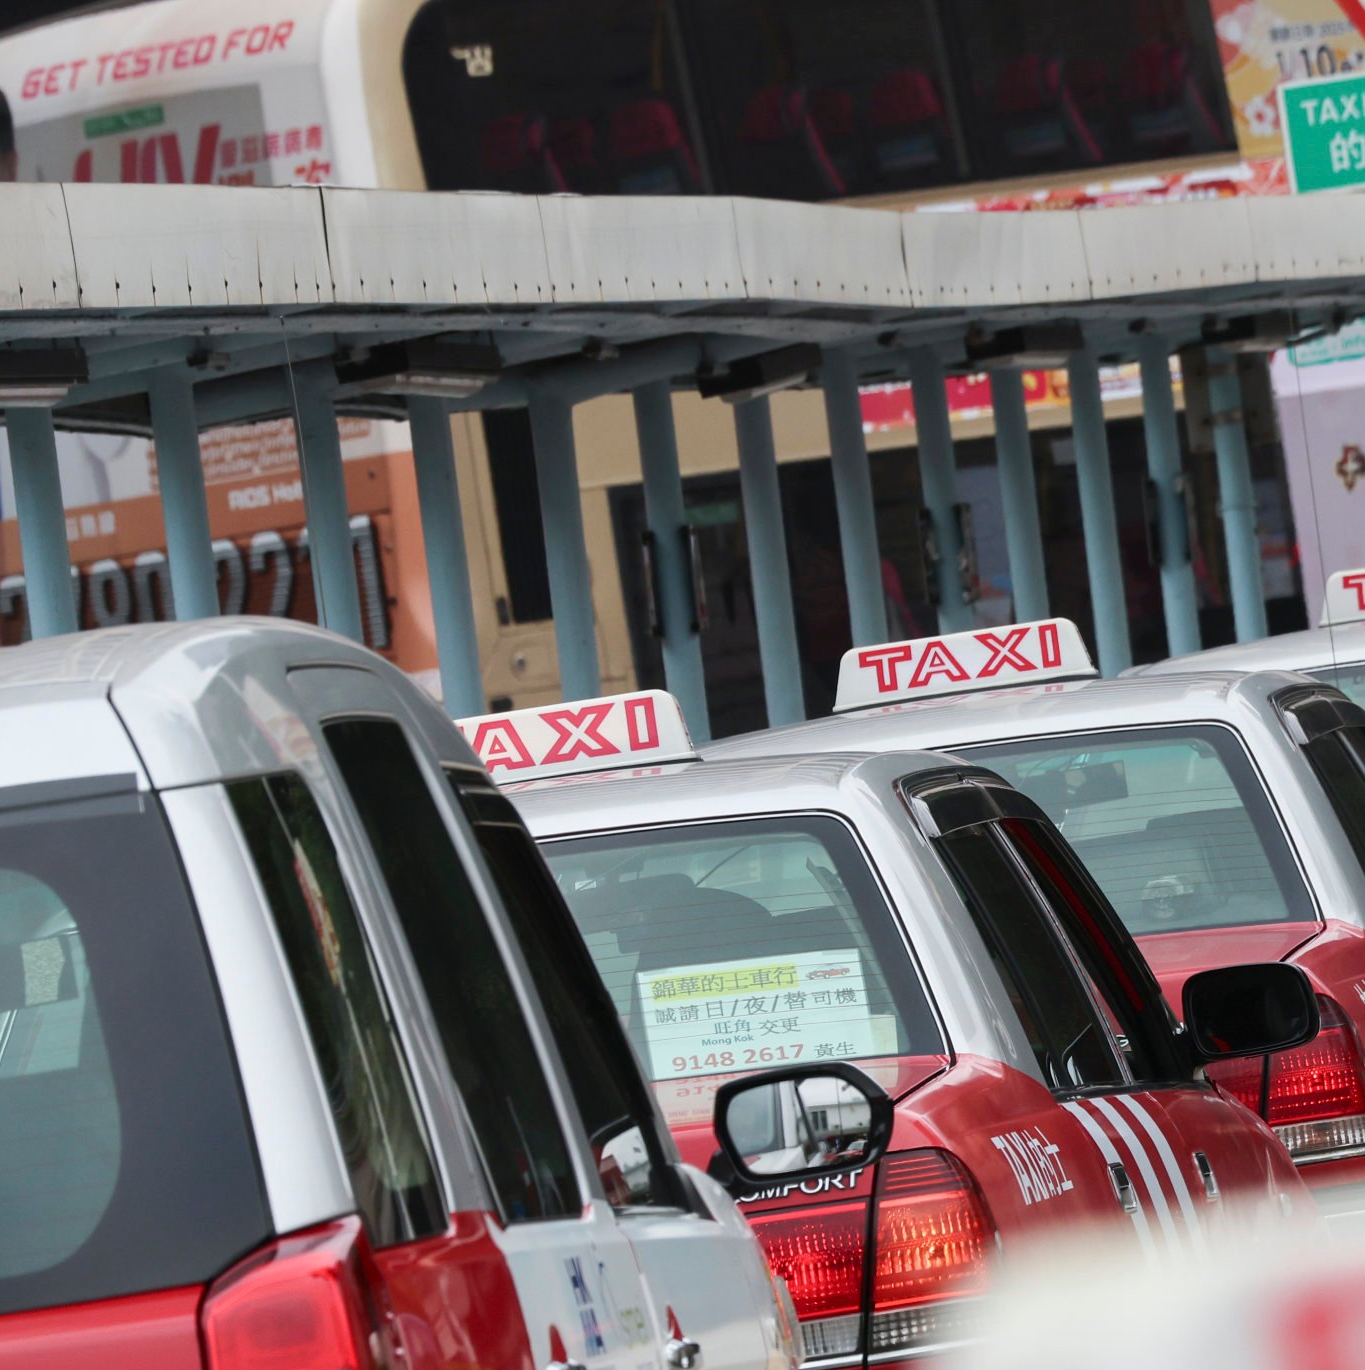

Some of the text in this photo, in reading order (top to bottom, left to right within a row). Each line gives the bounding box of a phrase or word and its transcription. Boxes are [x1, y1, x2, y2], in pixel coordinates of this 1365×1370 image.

[20, 20, 296, 100] GET TESTED FOR
[858, 623, 1063, 694] TAXI
[458, 696, 660, 774] AXI
[651, 965, 799, 1002] 錦華的士車行
[701, 1033, 755, 1047] Mong Kok
[713, 1015, 802, 1037] 旺角 交更
[671, 1050, 736, 1072] 9148
[742, 1043, 805, 1065] 2617
[990, 1126, 1075, 1206] TAXI 的士
